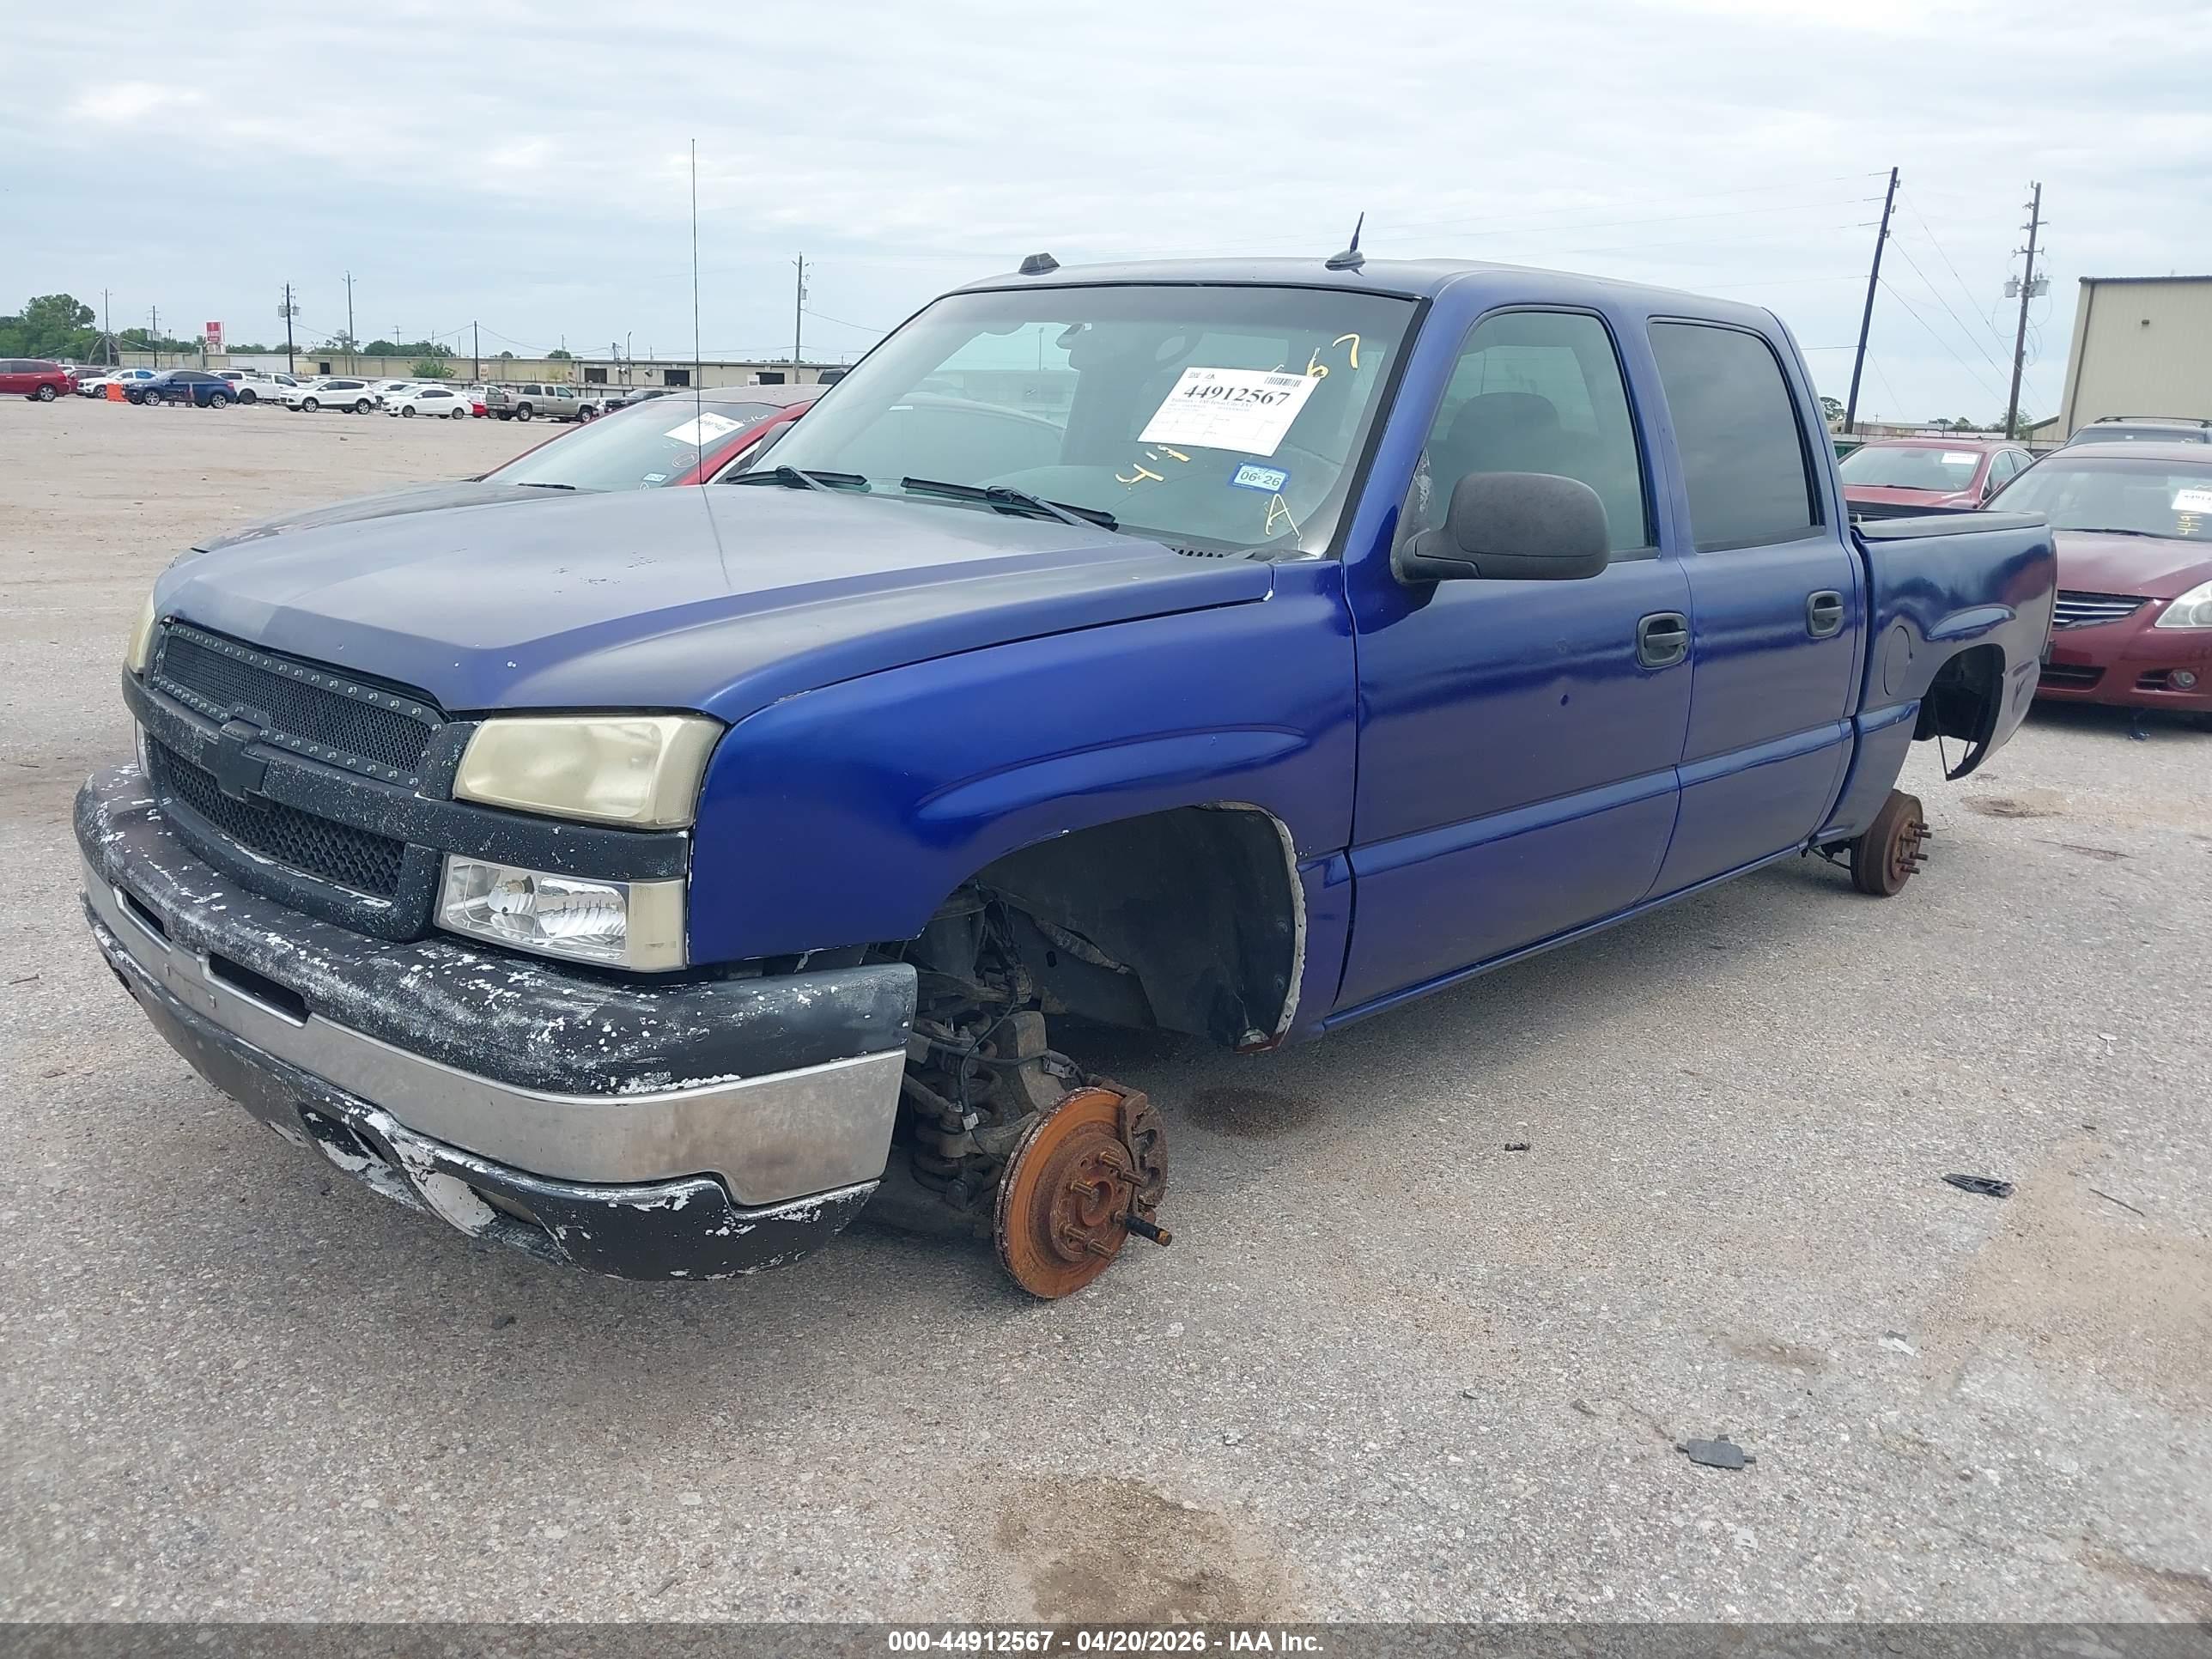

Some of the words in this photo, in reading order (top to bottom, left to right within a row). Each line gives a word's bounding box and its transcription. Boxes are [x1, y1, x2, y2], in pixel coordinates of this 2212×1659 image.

[1183, 385, 1291, 406] 44912567
[1240, 471, 1259, 482] 06
[1262, 475, 1282, 487] 26
[1265, 494, 1300, 538] A
